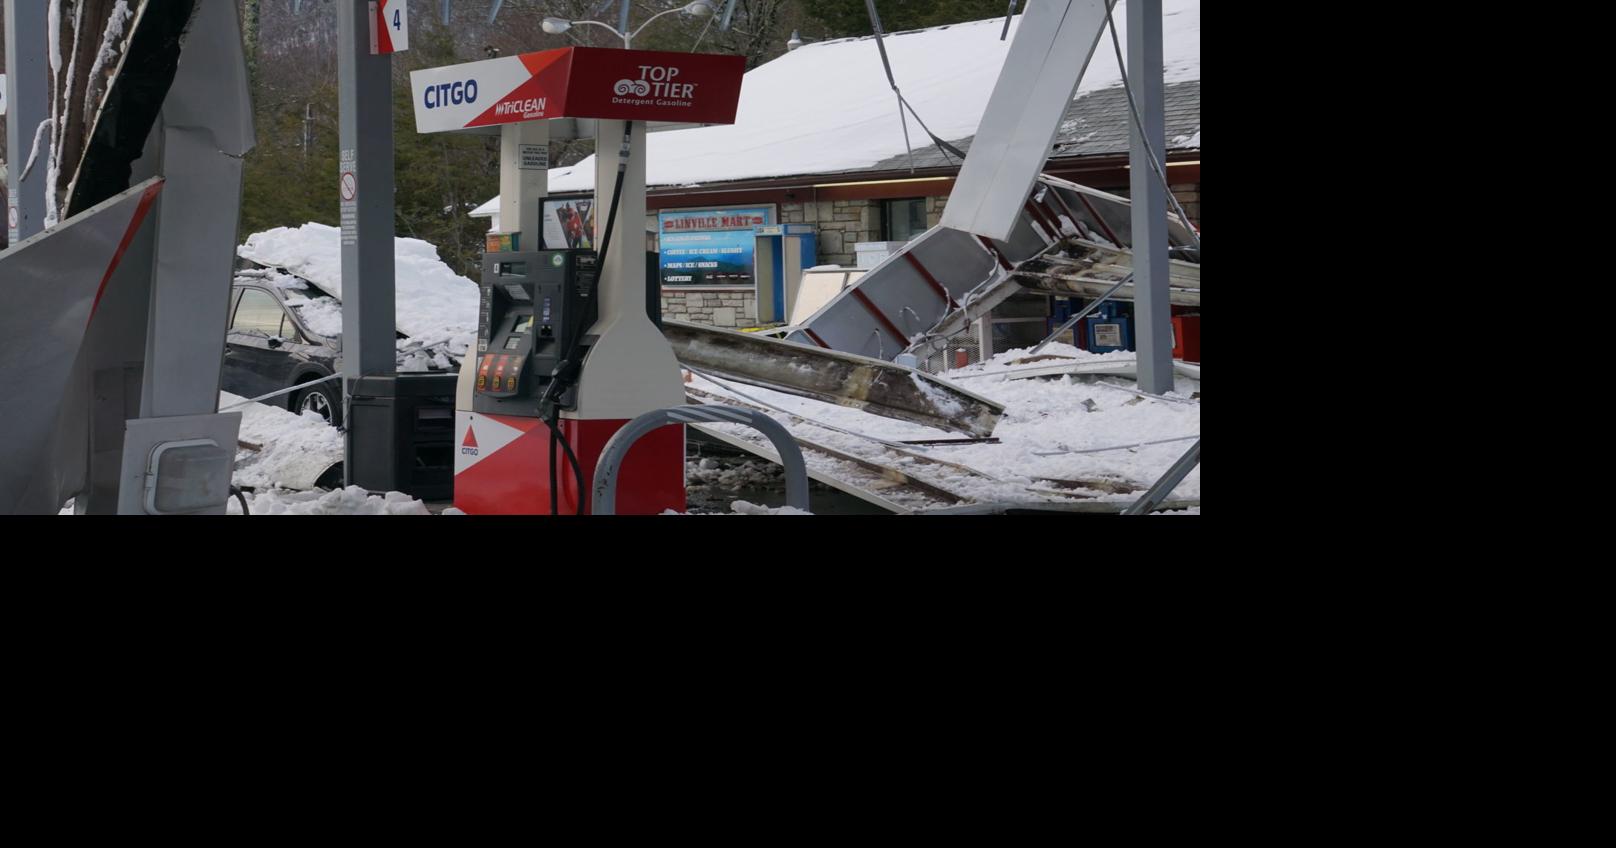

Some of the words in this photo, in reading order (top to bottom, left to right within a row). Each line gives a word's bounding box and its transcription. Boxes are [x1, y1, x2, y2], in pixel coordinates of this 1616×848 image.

[393, 9, 401, 31] 4
[637, 65, 679, 81] TOP
[424, 79, 478, 109] CITGO
[652, 82, 694, 98] TIER
[612, 96, 653, 107] Detergent
[656, 98, 692, 107] Gasoline
[523, 111, 545, 119] Gasoline
[675, 217, 718, 229] LINVILLE
[720, 215, 751, 227] MART
[462, 448, 479, 456] CITGO
